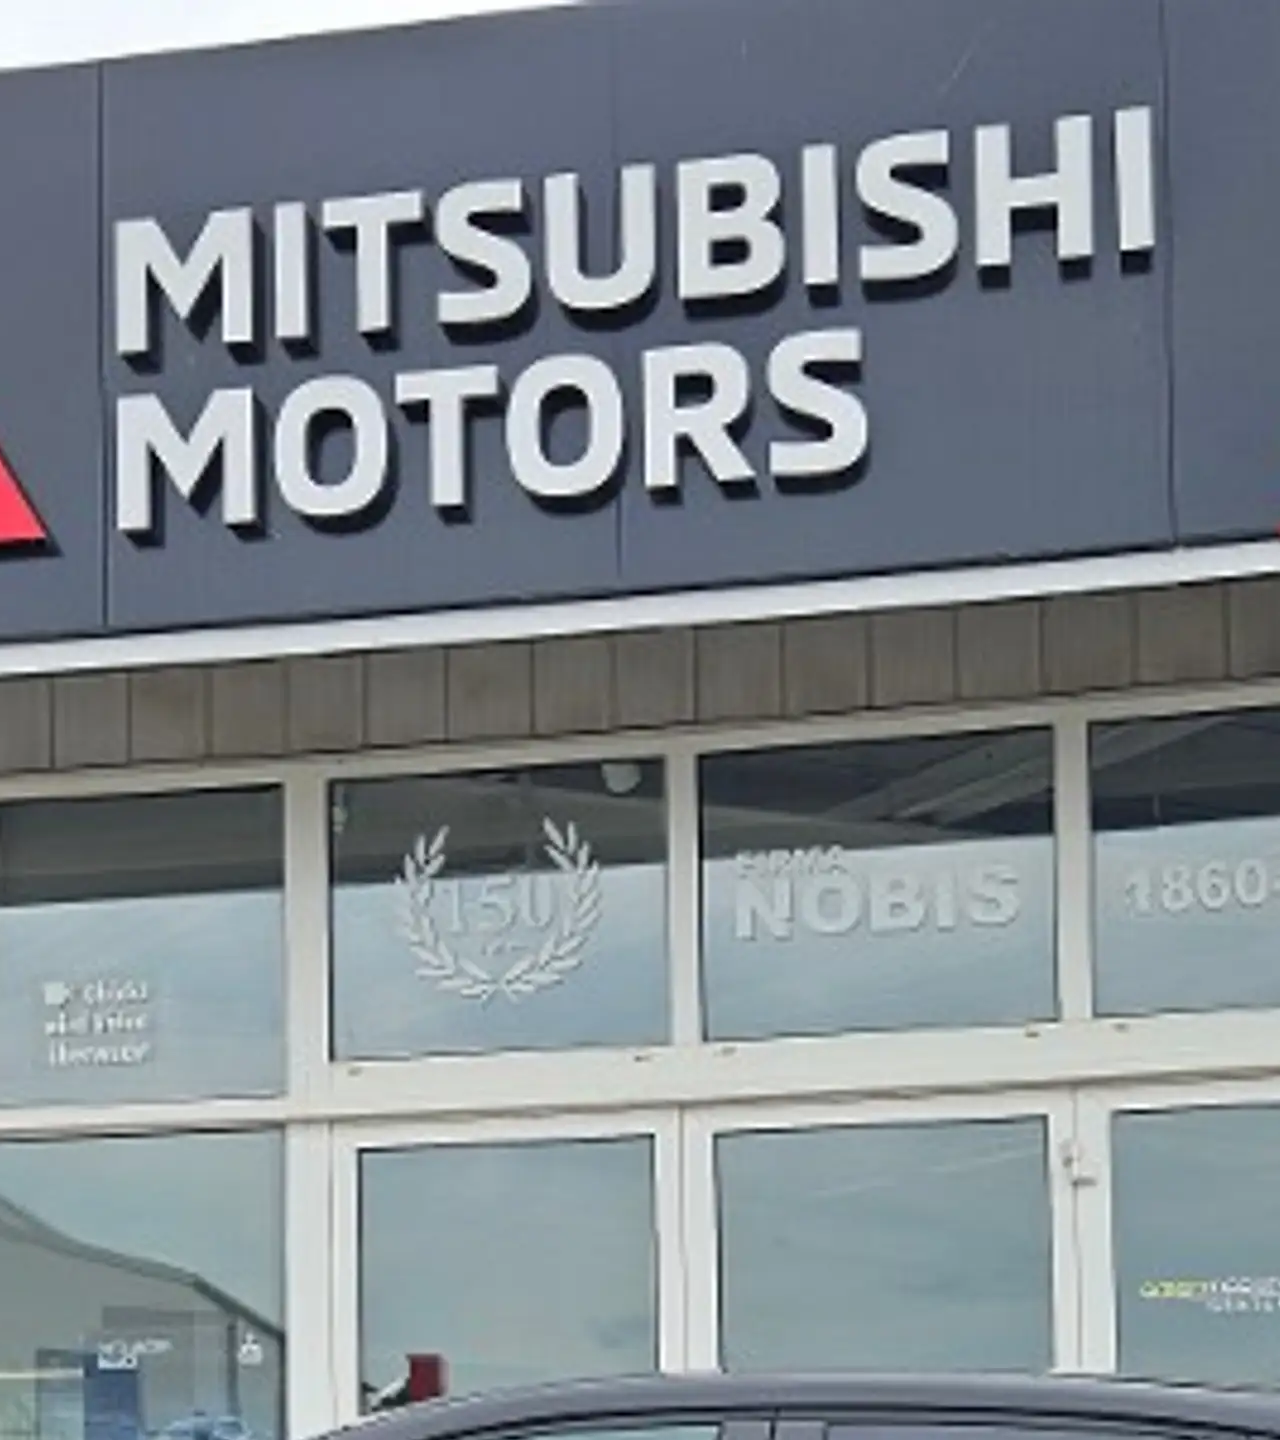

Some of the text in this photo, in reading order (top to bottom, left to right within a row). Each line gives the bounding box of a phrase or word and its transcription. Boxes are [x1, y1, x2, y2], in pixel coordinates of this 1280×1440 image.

[114, 105, 1156, 355] MITSUBISHI
[115, 328, 870, 532] MOTORS
[733, 864, 1021, 940] NOBIS
